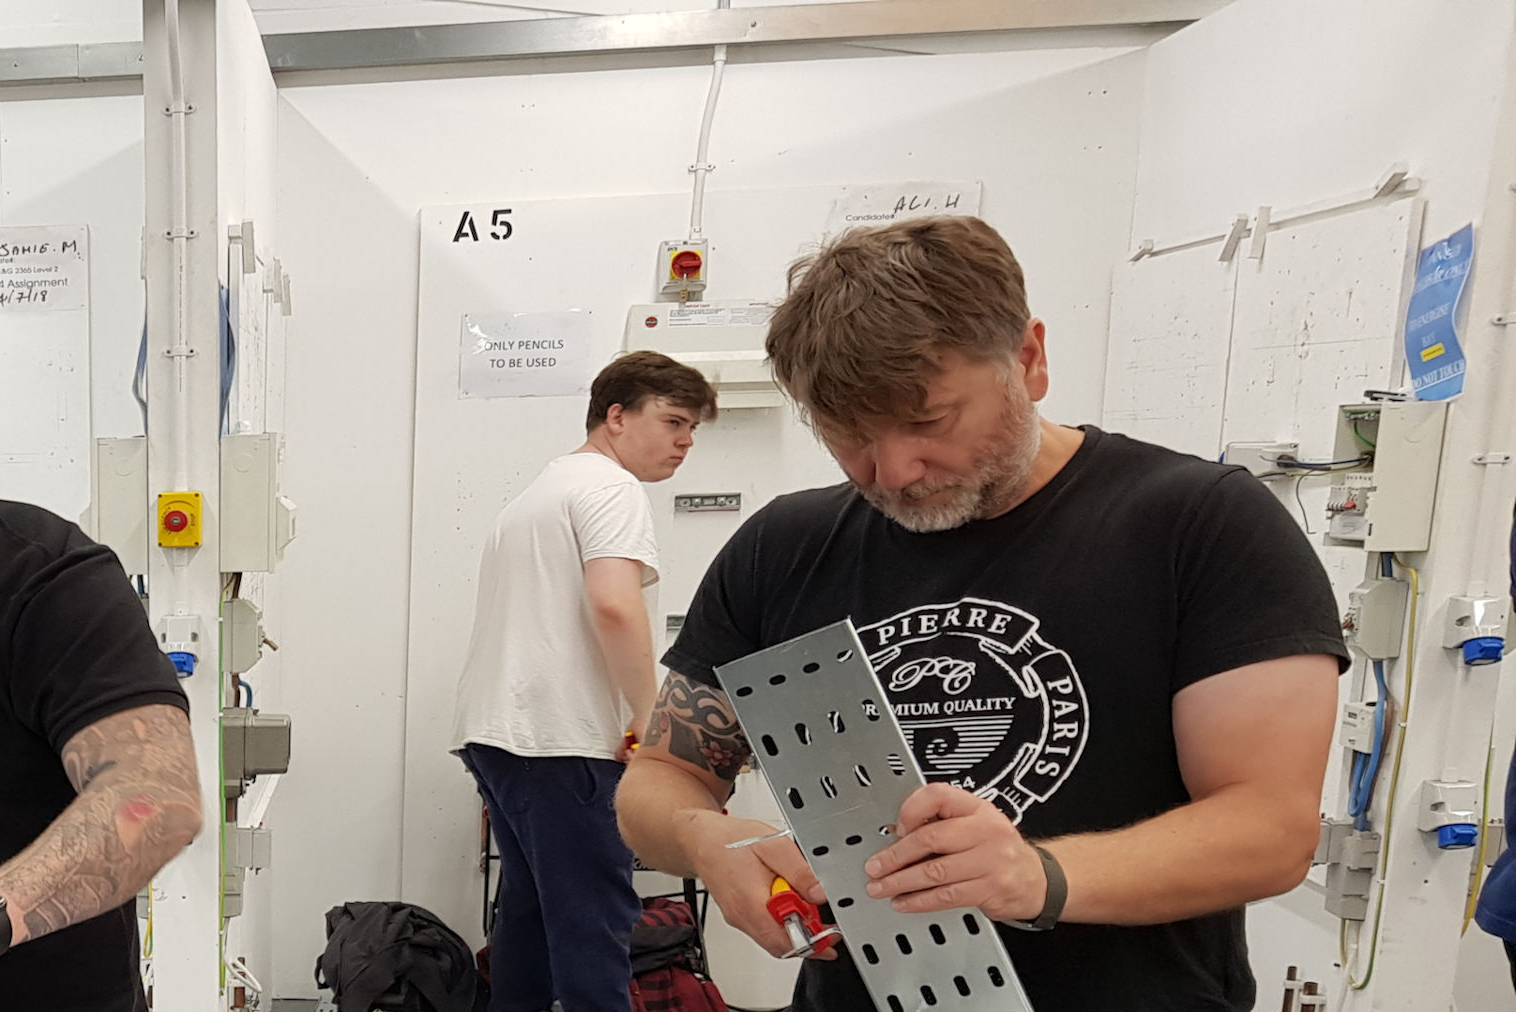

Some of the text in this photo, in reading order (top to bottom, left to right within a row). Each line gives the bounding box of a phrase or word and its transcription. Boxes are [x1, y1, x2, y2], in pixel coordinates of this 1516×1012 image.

[7, 277, 68, 289] Assignment
[484, 339, 564, 351] ONLY PENCILS
[490, 357, 557, 368] TO BE USED
[877, 607, 1012, 646] PIERRE
[943, 697, 1016, 716] QUALITY
[1034, 675, 1079, 777] PARIS
